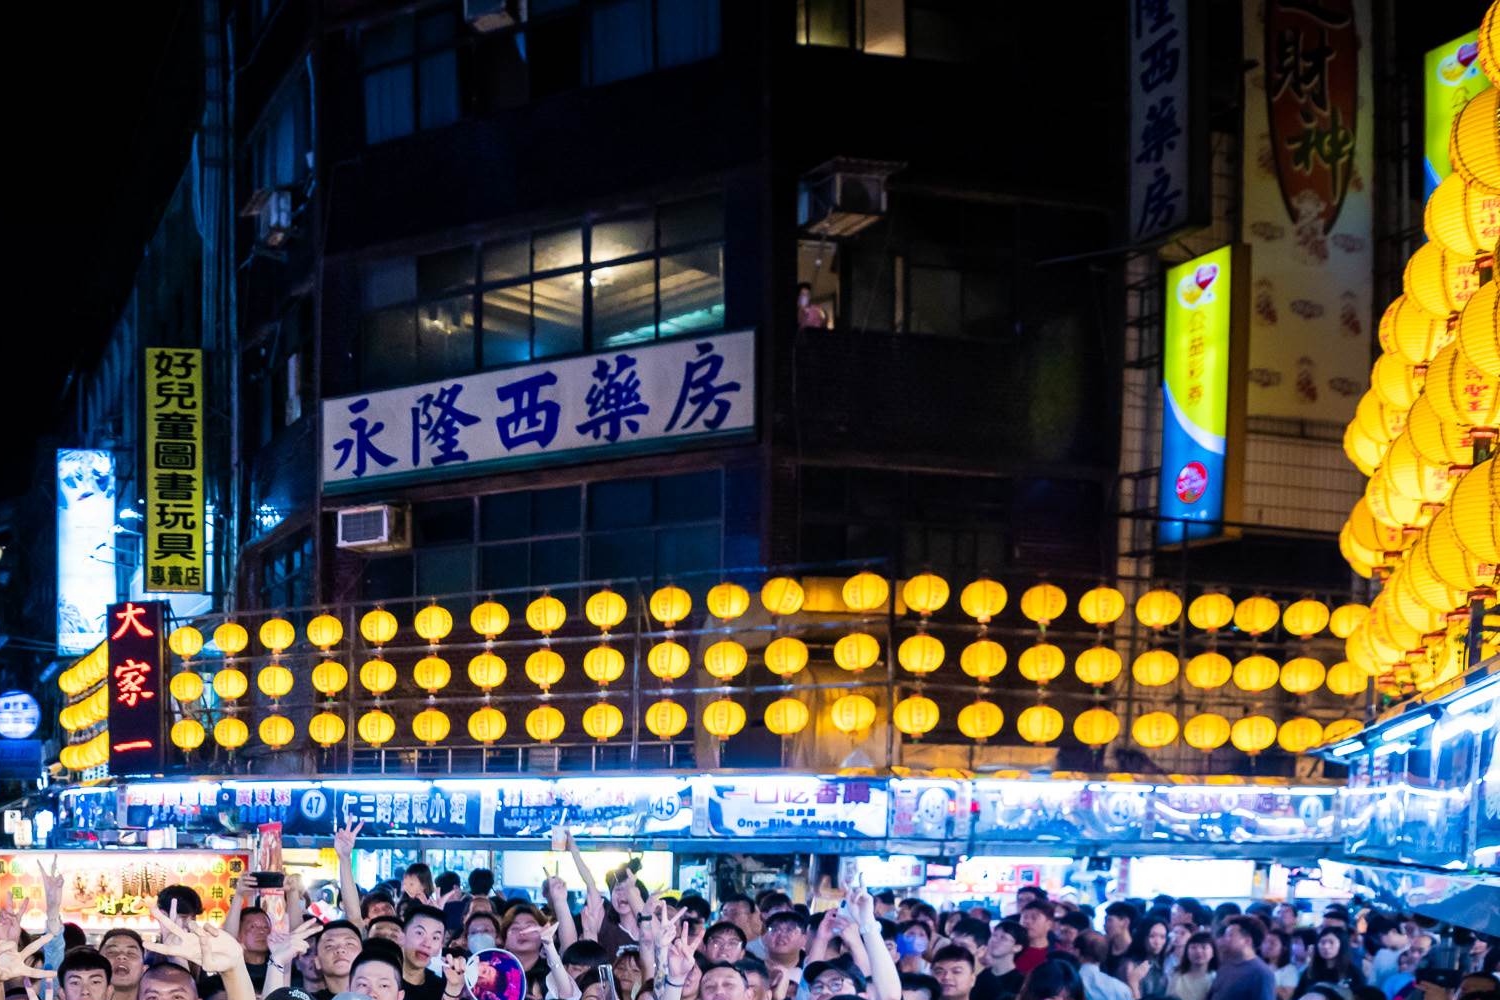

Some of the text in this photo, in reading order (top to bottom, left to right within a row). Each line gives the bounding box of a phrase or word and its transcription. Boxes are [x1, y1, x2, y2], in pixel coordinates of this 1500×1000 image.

[153, 350, 199, 562] 好兒童圖書玩具
[332, 342, 743, 478] 永隆西藥房
[149, 565, 200, 585] 專賣店
[112, 602, 155, 753] 大家一
